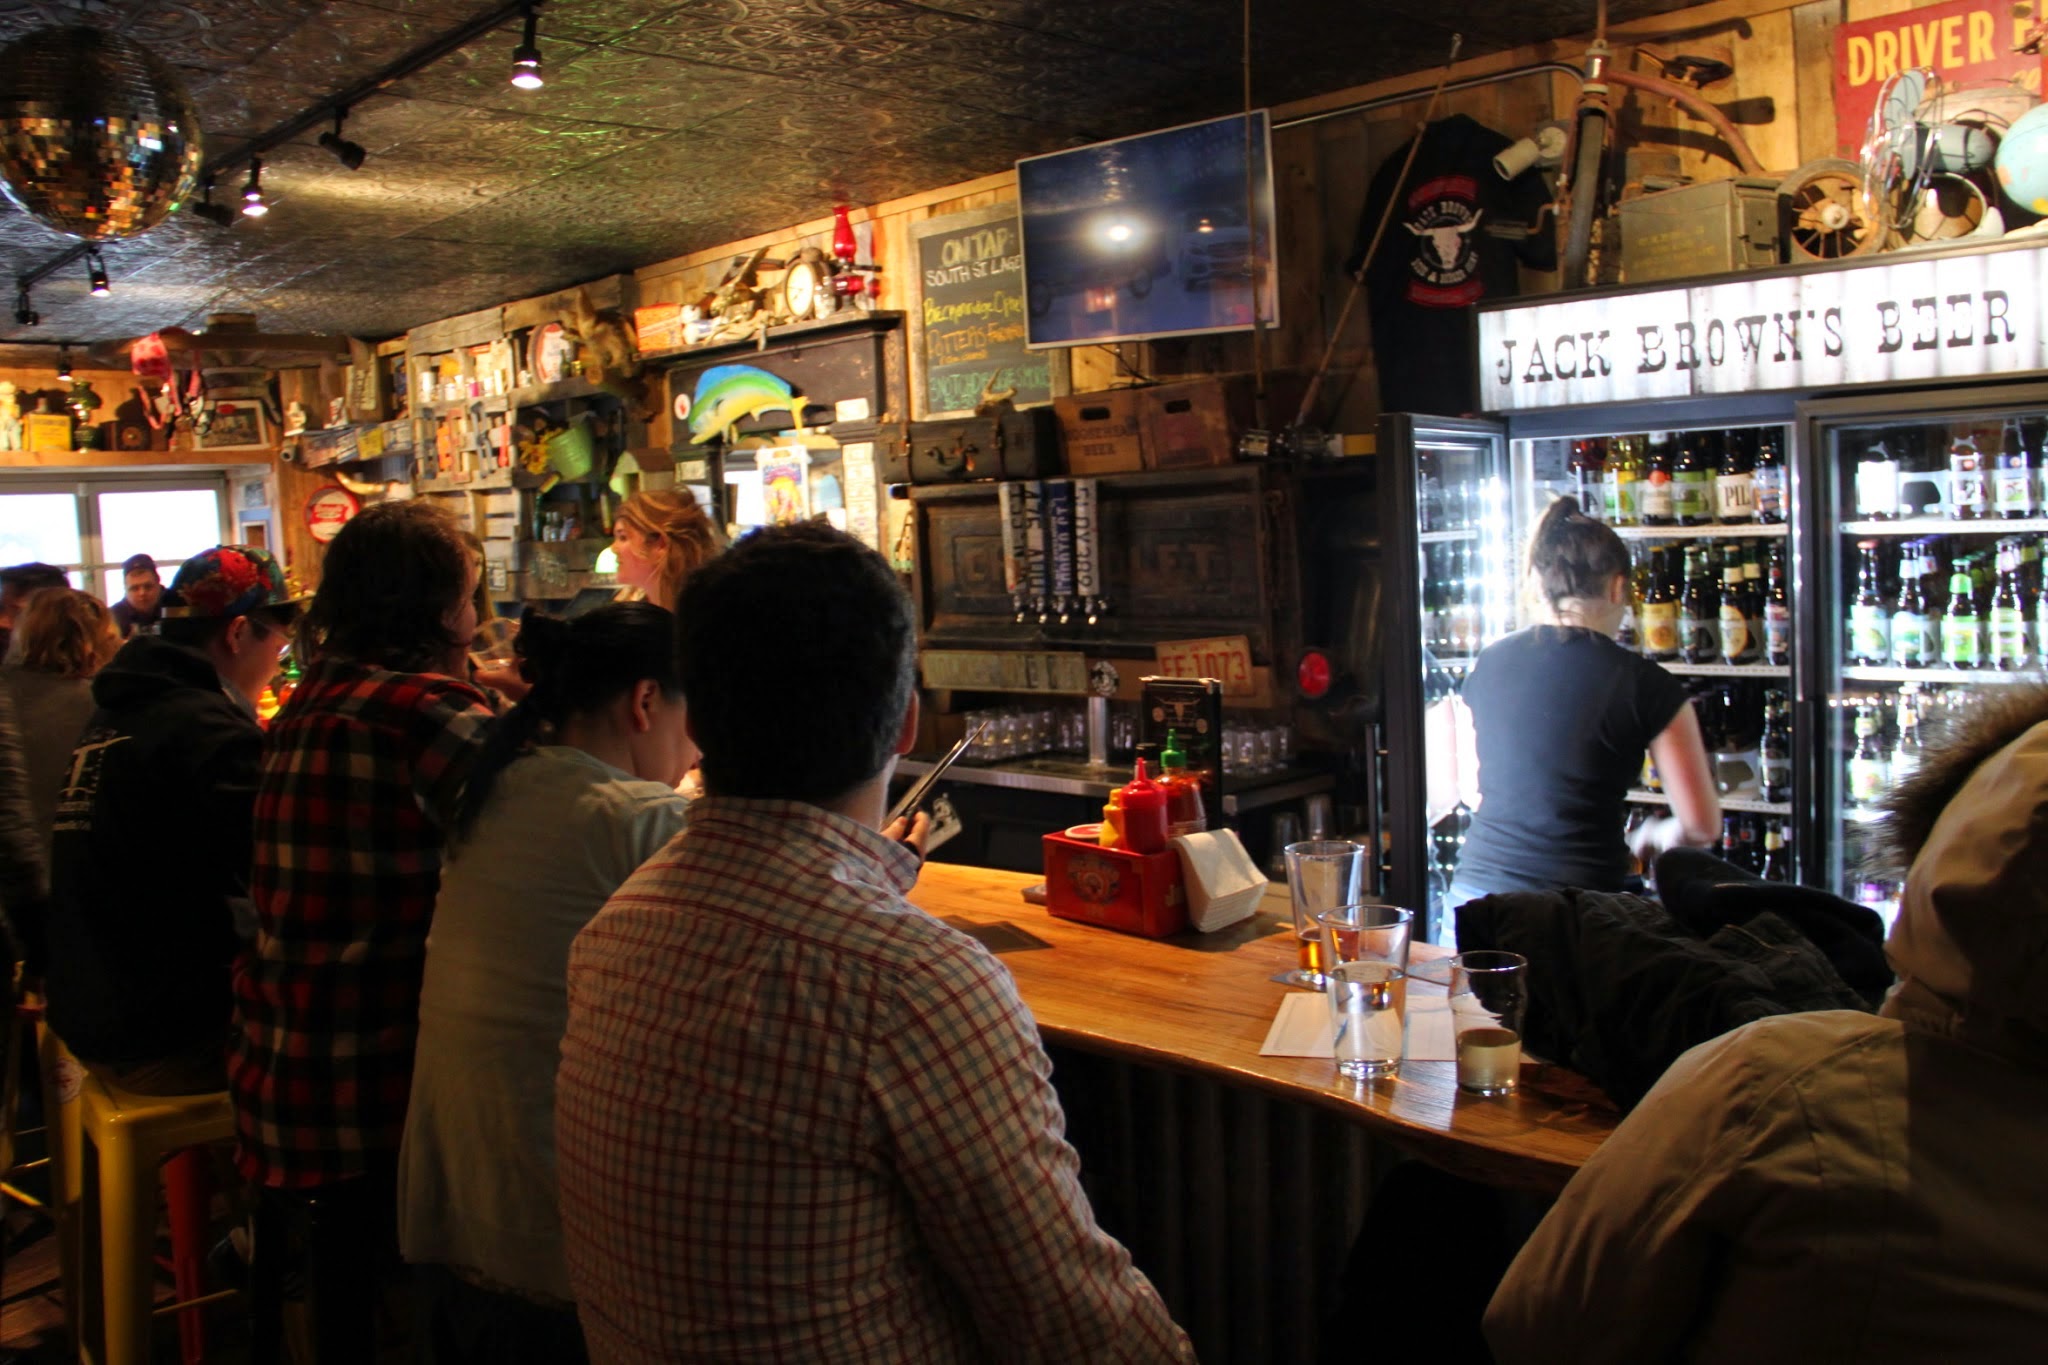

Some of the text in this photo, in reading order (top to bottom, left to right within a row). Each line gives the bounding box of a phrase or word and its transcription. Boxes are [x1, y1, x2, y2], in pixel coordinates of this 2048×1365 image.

[1847, 10, 1997, 87] DRIVER
[925, 265, 972, 287] SOUTH
[1497, 290, 2016, 385] JACK BROWN'S BEER
